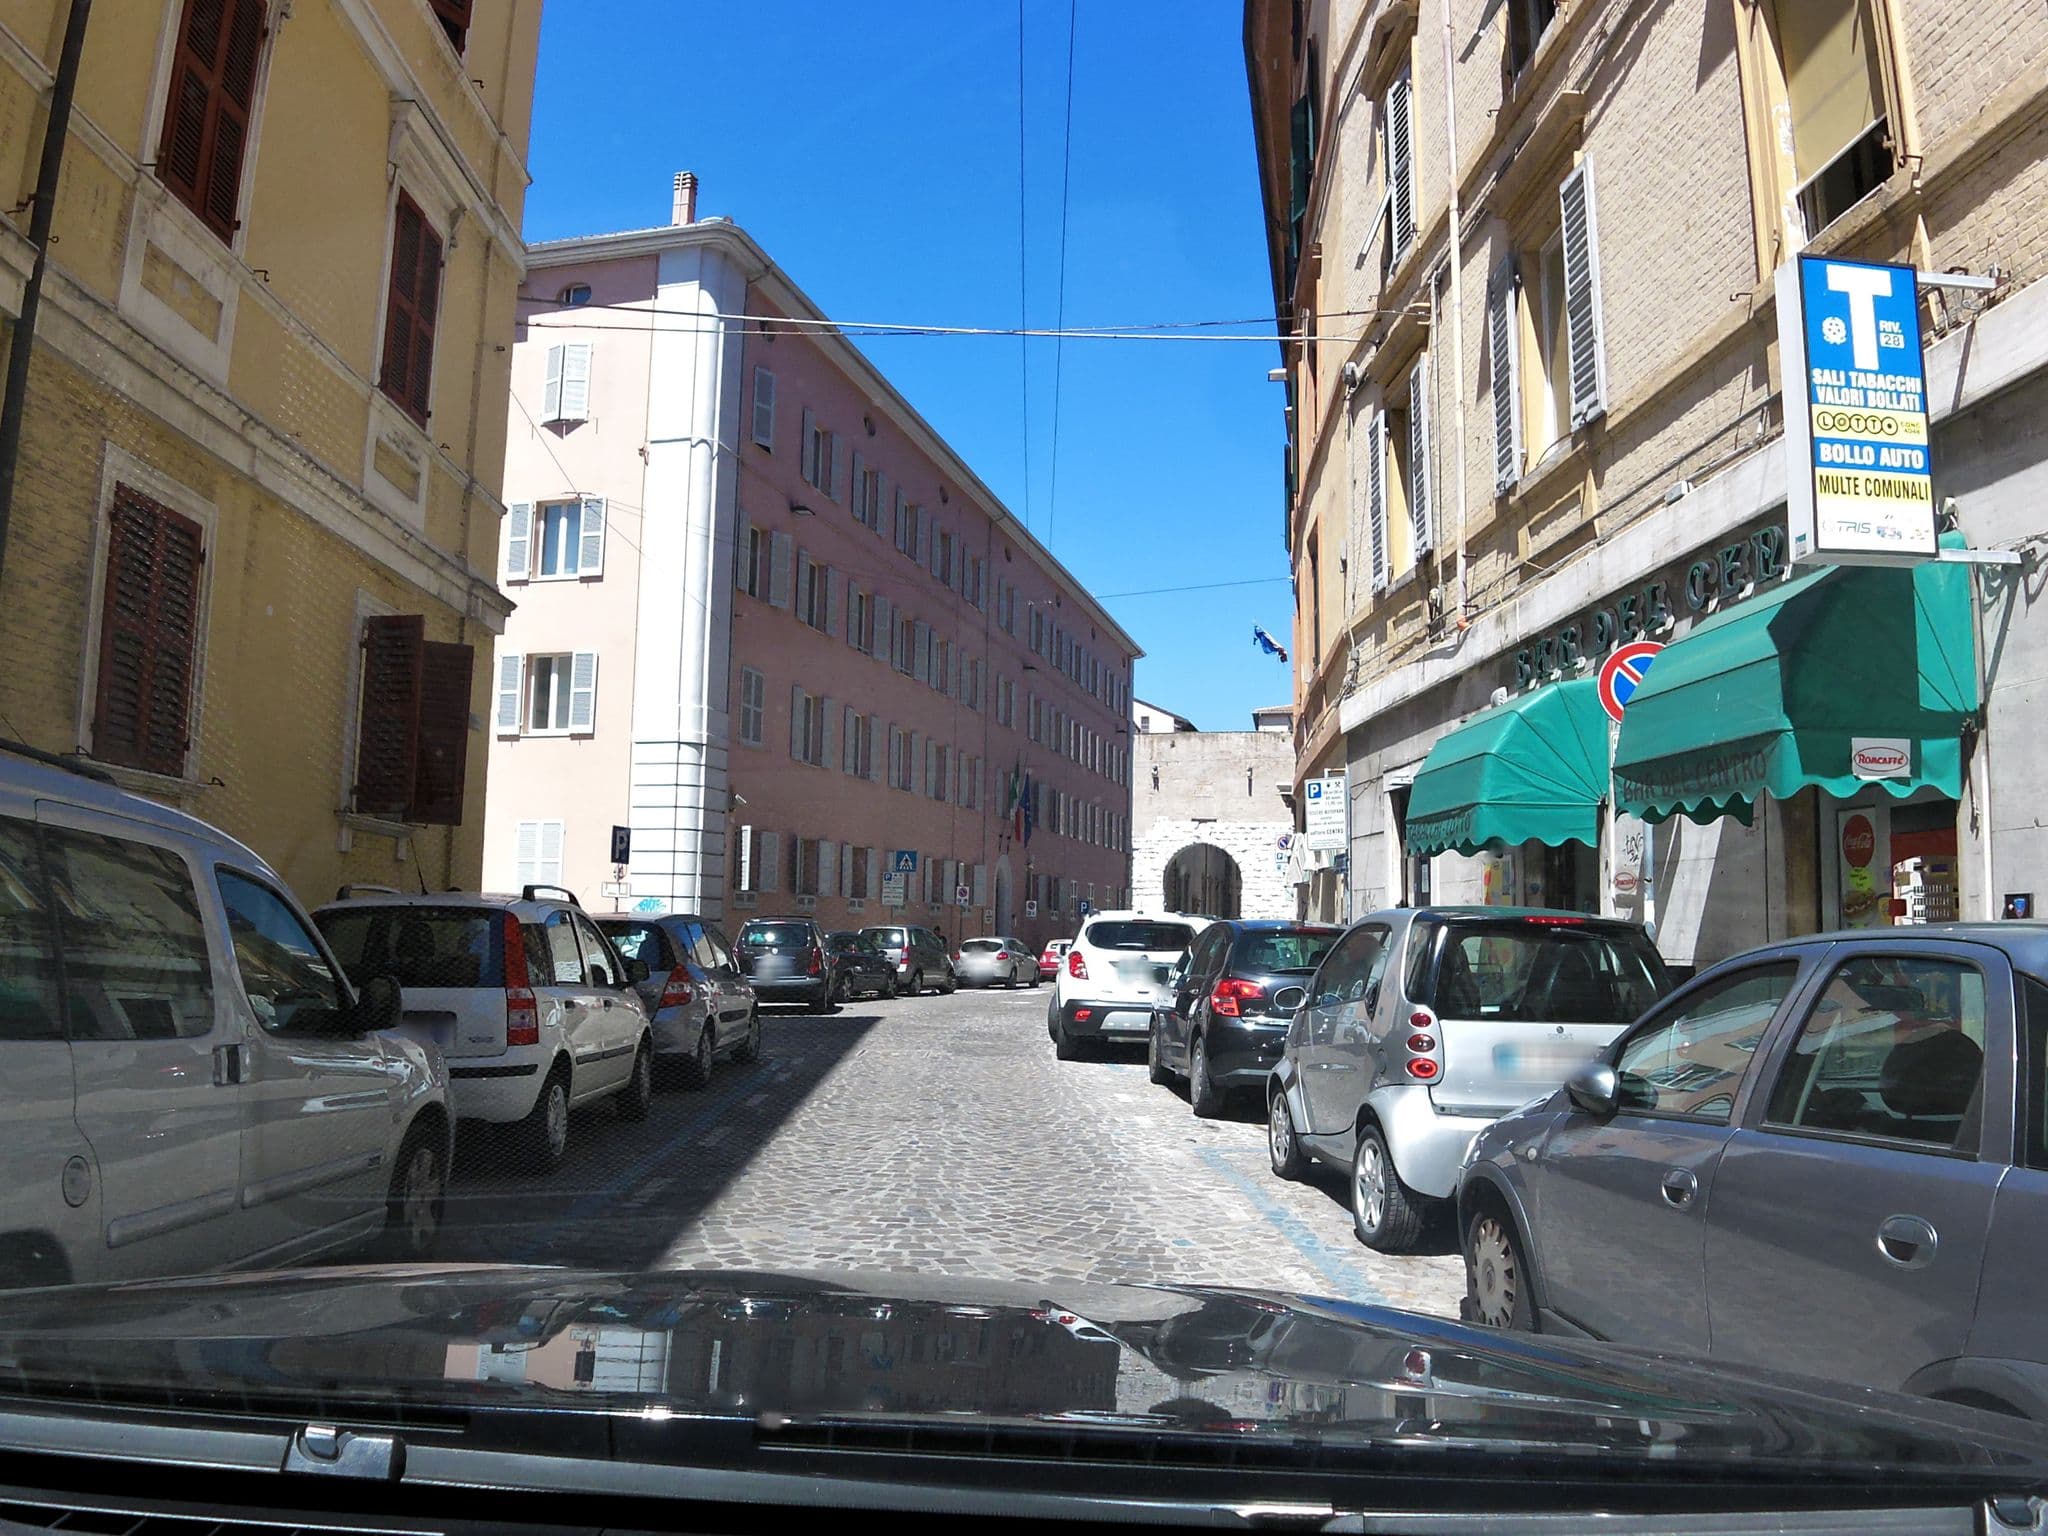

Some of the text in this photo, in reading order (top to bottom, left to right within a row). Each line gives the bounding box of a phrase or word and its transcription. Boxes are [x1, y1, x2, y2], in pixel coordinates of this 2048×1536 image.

[1826, 264, 1892, 371] T
[1879, 320, 1902, 333] RIV.
[1883, 335, 1900, 346] 28
[1812, 368, 1921, 392] SALI TABACCHI
[1816, 386, 1920, 411] VALORI BOLLATI
[1817, 411, 1898, 436] LOTTO
[1820, 443, 1924, 469] BOLLO AUTO
[1819, 475, 1929, 500] MULTE COMUNALI
[1516, 624, 1582, 688] BAR
[1592, 583, 1672, 655] DEL
[1624, 772, 1656, 802] BAR
[1696, 750, 1766, 788] CENTRO
[1310, 784, 1319, 798] P
[615, 830, 628, 859] P
[1080, 901, 1088, 912] P
